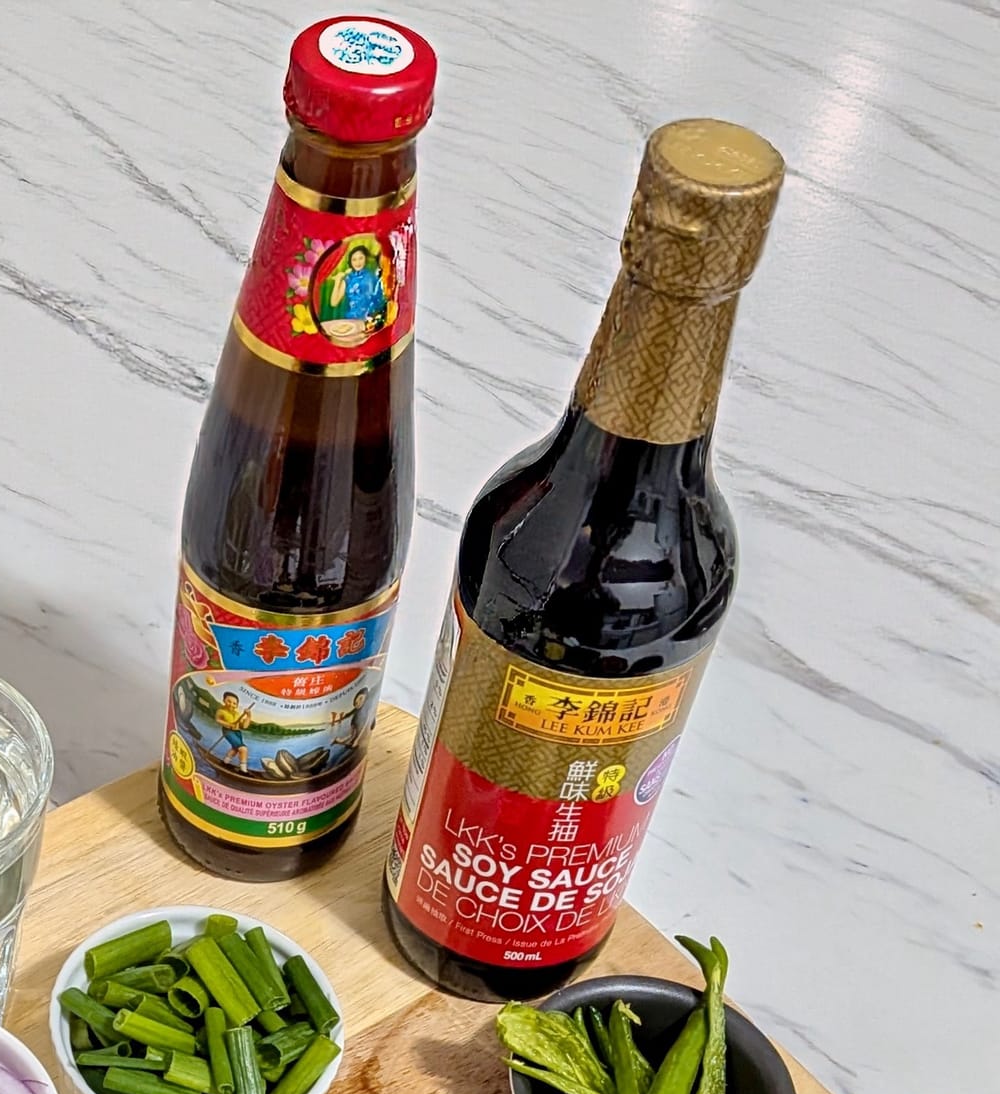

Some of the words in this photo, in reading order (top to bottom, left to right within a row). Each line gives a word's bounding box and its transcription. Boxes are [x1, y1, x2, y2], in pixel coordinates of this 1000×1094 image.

[514, 700, 541, 716] HONG
[545, 695, 653, 724] 李錦記
[540, 719, 569, 734] LEE
[573, 726, 612, 736] KUM
[616, 719, 646, 735] KEE
[225, 793, 263, 809] PREMIUM
[265, 801, 299, 809] OYSTER
[547, 760, 599, 842] 鮮味生抽
[267, 821, 295, 835] 510
[296, 821, 307, 834] g
[444, 807, 517, 861] LKK's
[420, 843, 524, 910] SAUCE
[529, 888, 579, 912] DE
[452, 842, 523, 885] SOY
[527, 843, 634, 890] SAUCE
[416, 866, 451, 907] DE
[455, 896, 552, 934] CHOIX
[555, 903, 597, 932] DE
[454, 921, 475, 937] First
[476, 930, 503, 945] Press
[512, 939, 538, 949] Issue
[540, 940, 552, 948] de
[554, 936, 566, 946] La
[503, 950, 525, 961] 500
[524, 951, 542, 961] mL
